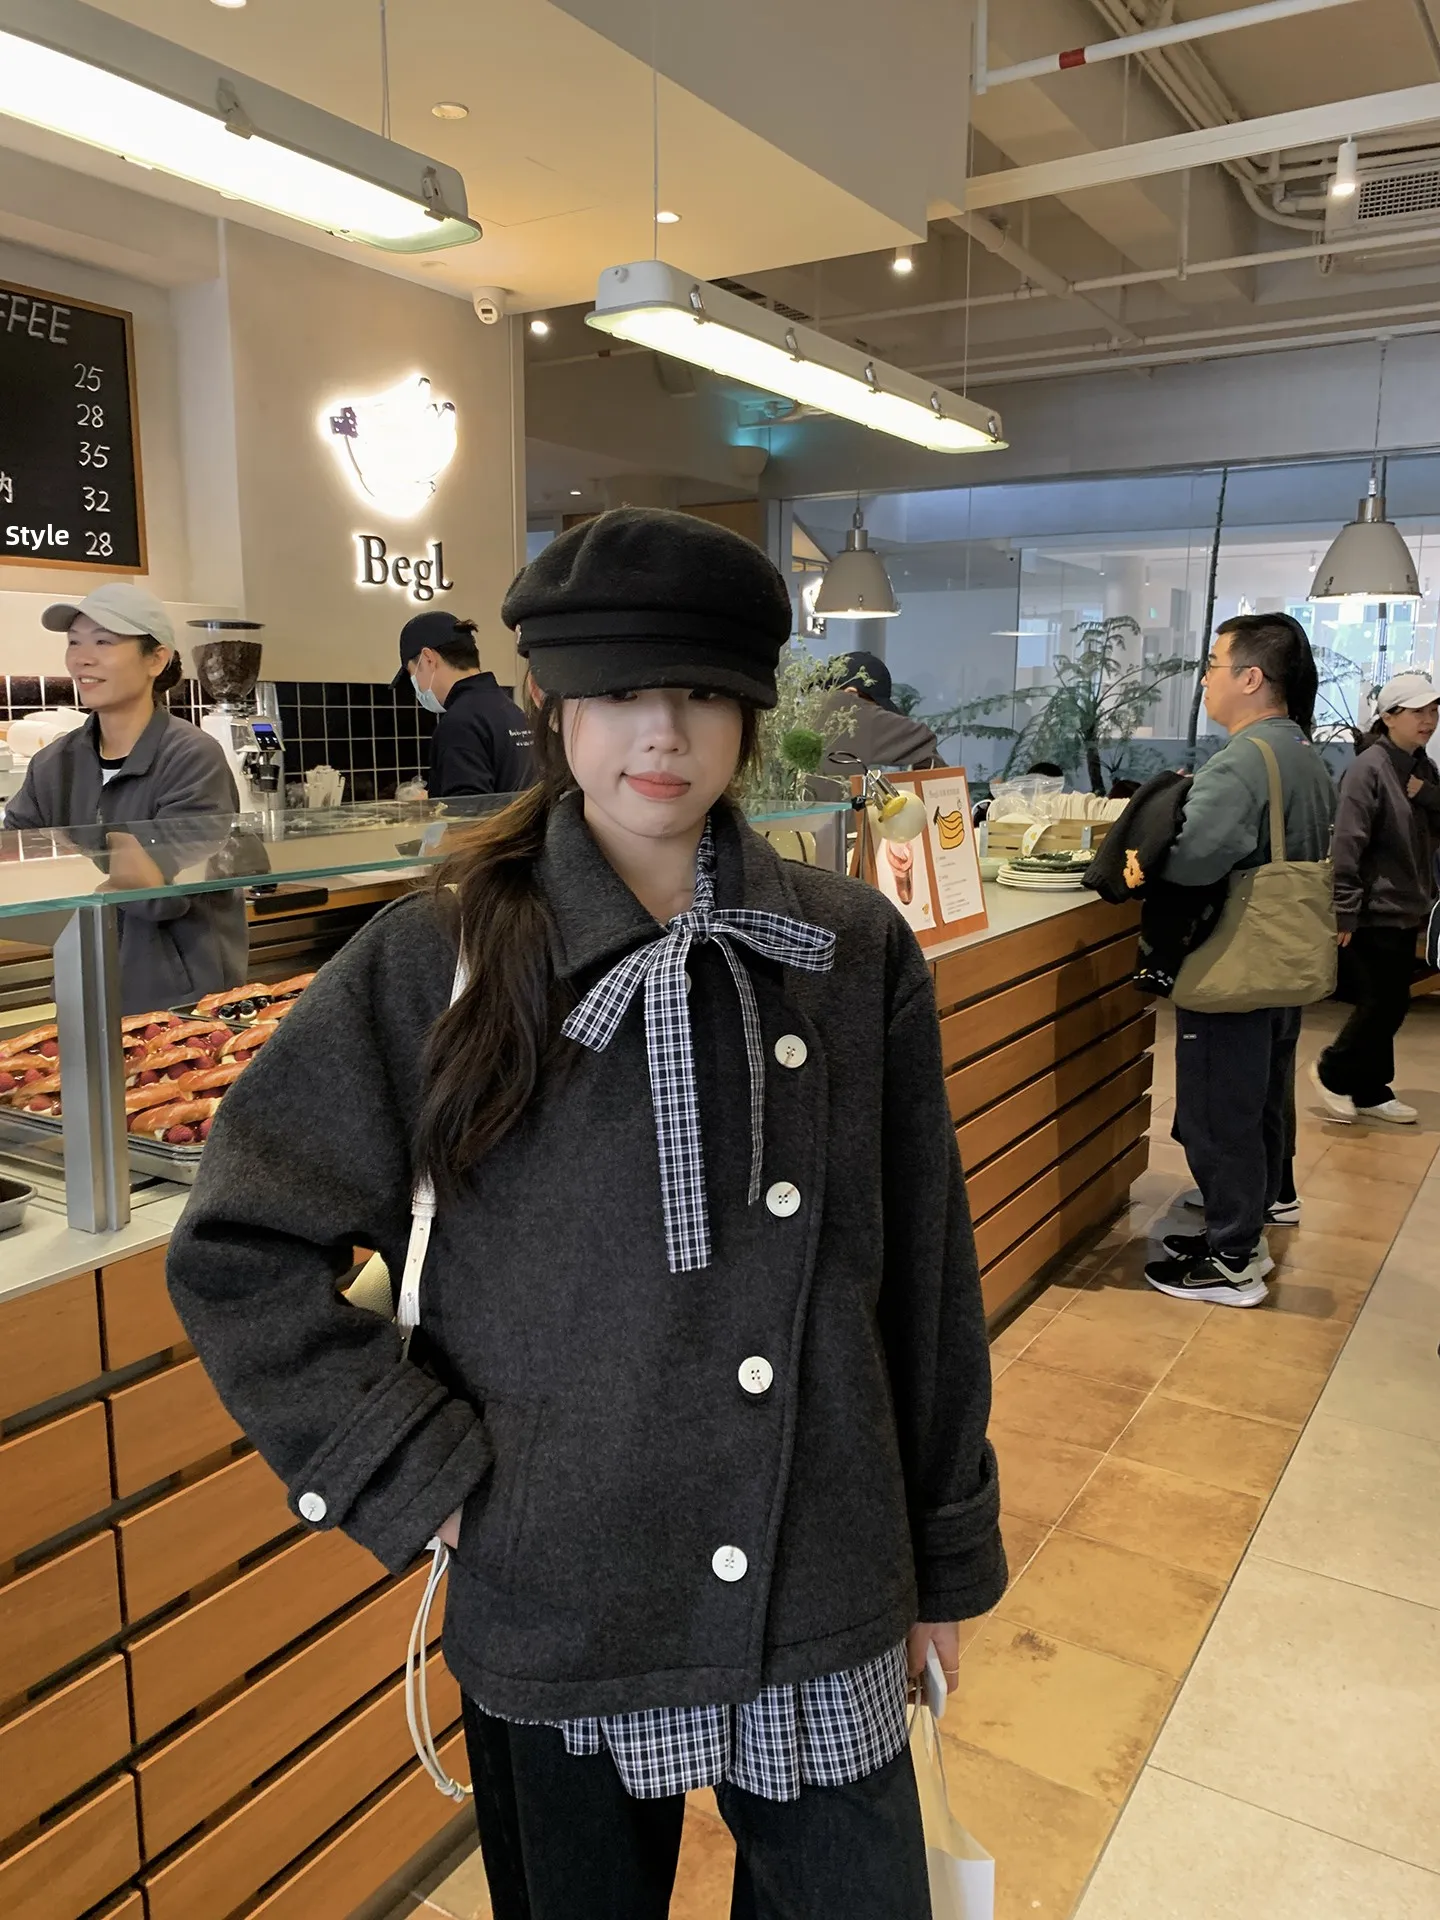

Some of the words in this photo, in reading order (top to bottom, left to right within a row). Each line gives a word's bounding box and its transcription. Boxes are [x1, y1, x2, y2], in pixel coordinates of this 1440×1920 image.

[74, 363, 104, 392] 25
[76, 403, 104, 428] 28
[78, 441, 110, 468] 35
[82, 486, 111, 513] 32
[85, 531, 113, 557] 28
[358, 534, 454, 601] Begl
